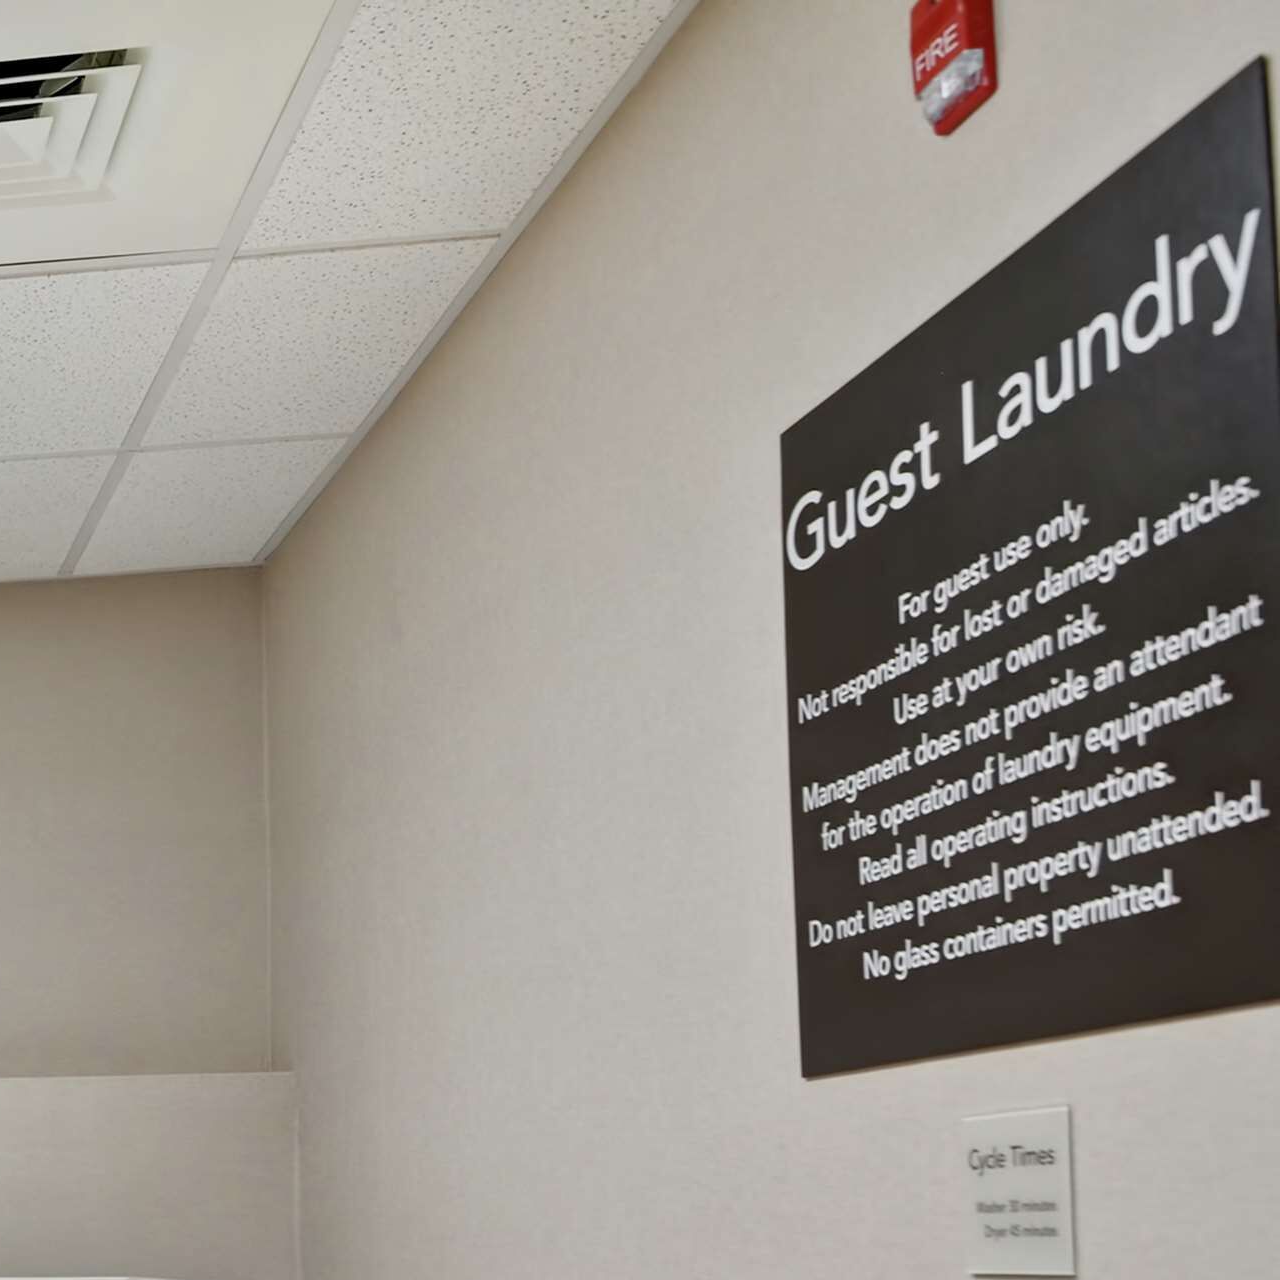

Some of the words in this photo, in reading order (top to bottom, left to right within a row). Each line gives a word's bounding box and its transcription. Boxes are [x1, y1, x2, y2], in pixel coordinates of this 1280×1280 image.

[915, 22, 960, 82] FIRE
[786, 420, 941, 571] Guest
[961, 208, 1261, 466] Laundry
[798, 690, 829, 724] Not
[832, 638, 929, 706] responsible
[931, 624, 961, 656] for
[964, 600, 1003, 641] lost
[1006, 588, 1032, 618] or
[1035, 517, 1149, 604] damaged
[1153, 476, 1261, 546] articles.
[898, 592, 931, 624] For
[933, 553, 991, 614] guest
[993, 535, 1033, 572] use
[1035, 500, 1090, 542] only.
[802, 747, 912, 812] Management
[914, 729, 961, 766] does
[965, 708, 1001, 746] not
[1004, 668, 1089, 740] provide
[1093, 659, 1126, 692] an
[1129, 594, 1264, 677] attendant
[893, 692, 929, 725] Use
[932, 677, 953, 708] at
[955, 656, 1002, 706] your
[1005, 635, 1053, 673] own
[1057, 604, 1107, 650] risk.
[821, 821, 846, 851] for
[848, 810, 878, 841] the
[880, 779, 969, 836] operation
[972, 756, 995, 794] of
[998, 731, 1082, 786] laundry
[1084, 673, 1234, 754] equipment.
[858, 843, 903, 886] Read
[906, 834, 927, 870] all
[930, 810, 1027, 869] operating
[1031, 762, 1177, 829] instructions.
[808, 919, 833, 947] Do
[836, 910, 865, 940] not
[867, 901, 914, 930] leave
[917, 862, 1000, 928] personal
[1003, 841, 1103, 903] property
[1106, 779, 1271, 862] unattended.
[862, 949, 891, 980] No
[893, 938, 940, 981] glass
[943, 916, 1049, 961] containers
[1051, 868, 1182, 946] permitted.
[968, 1146, 1006, 1177] Cycle
[1009, 1145, 1056, 1167] Times
